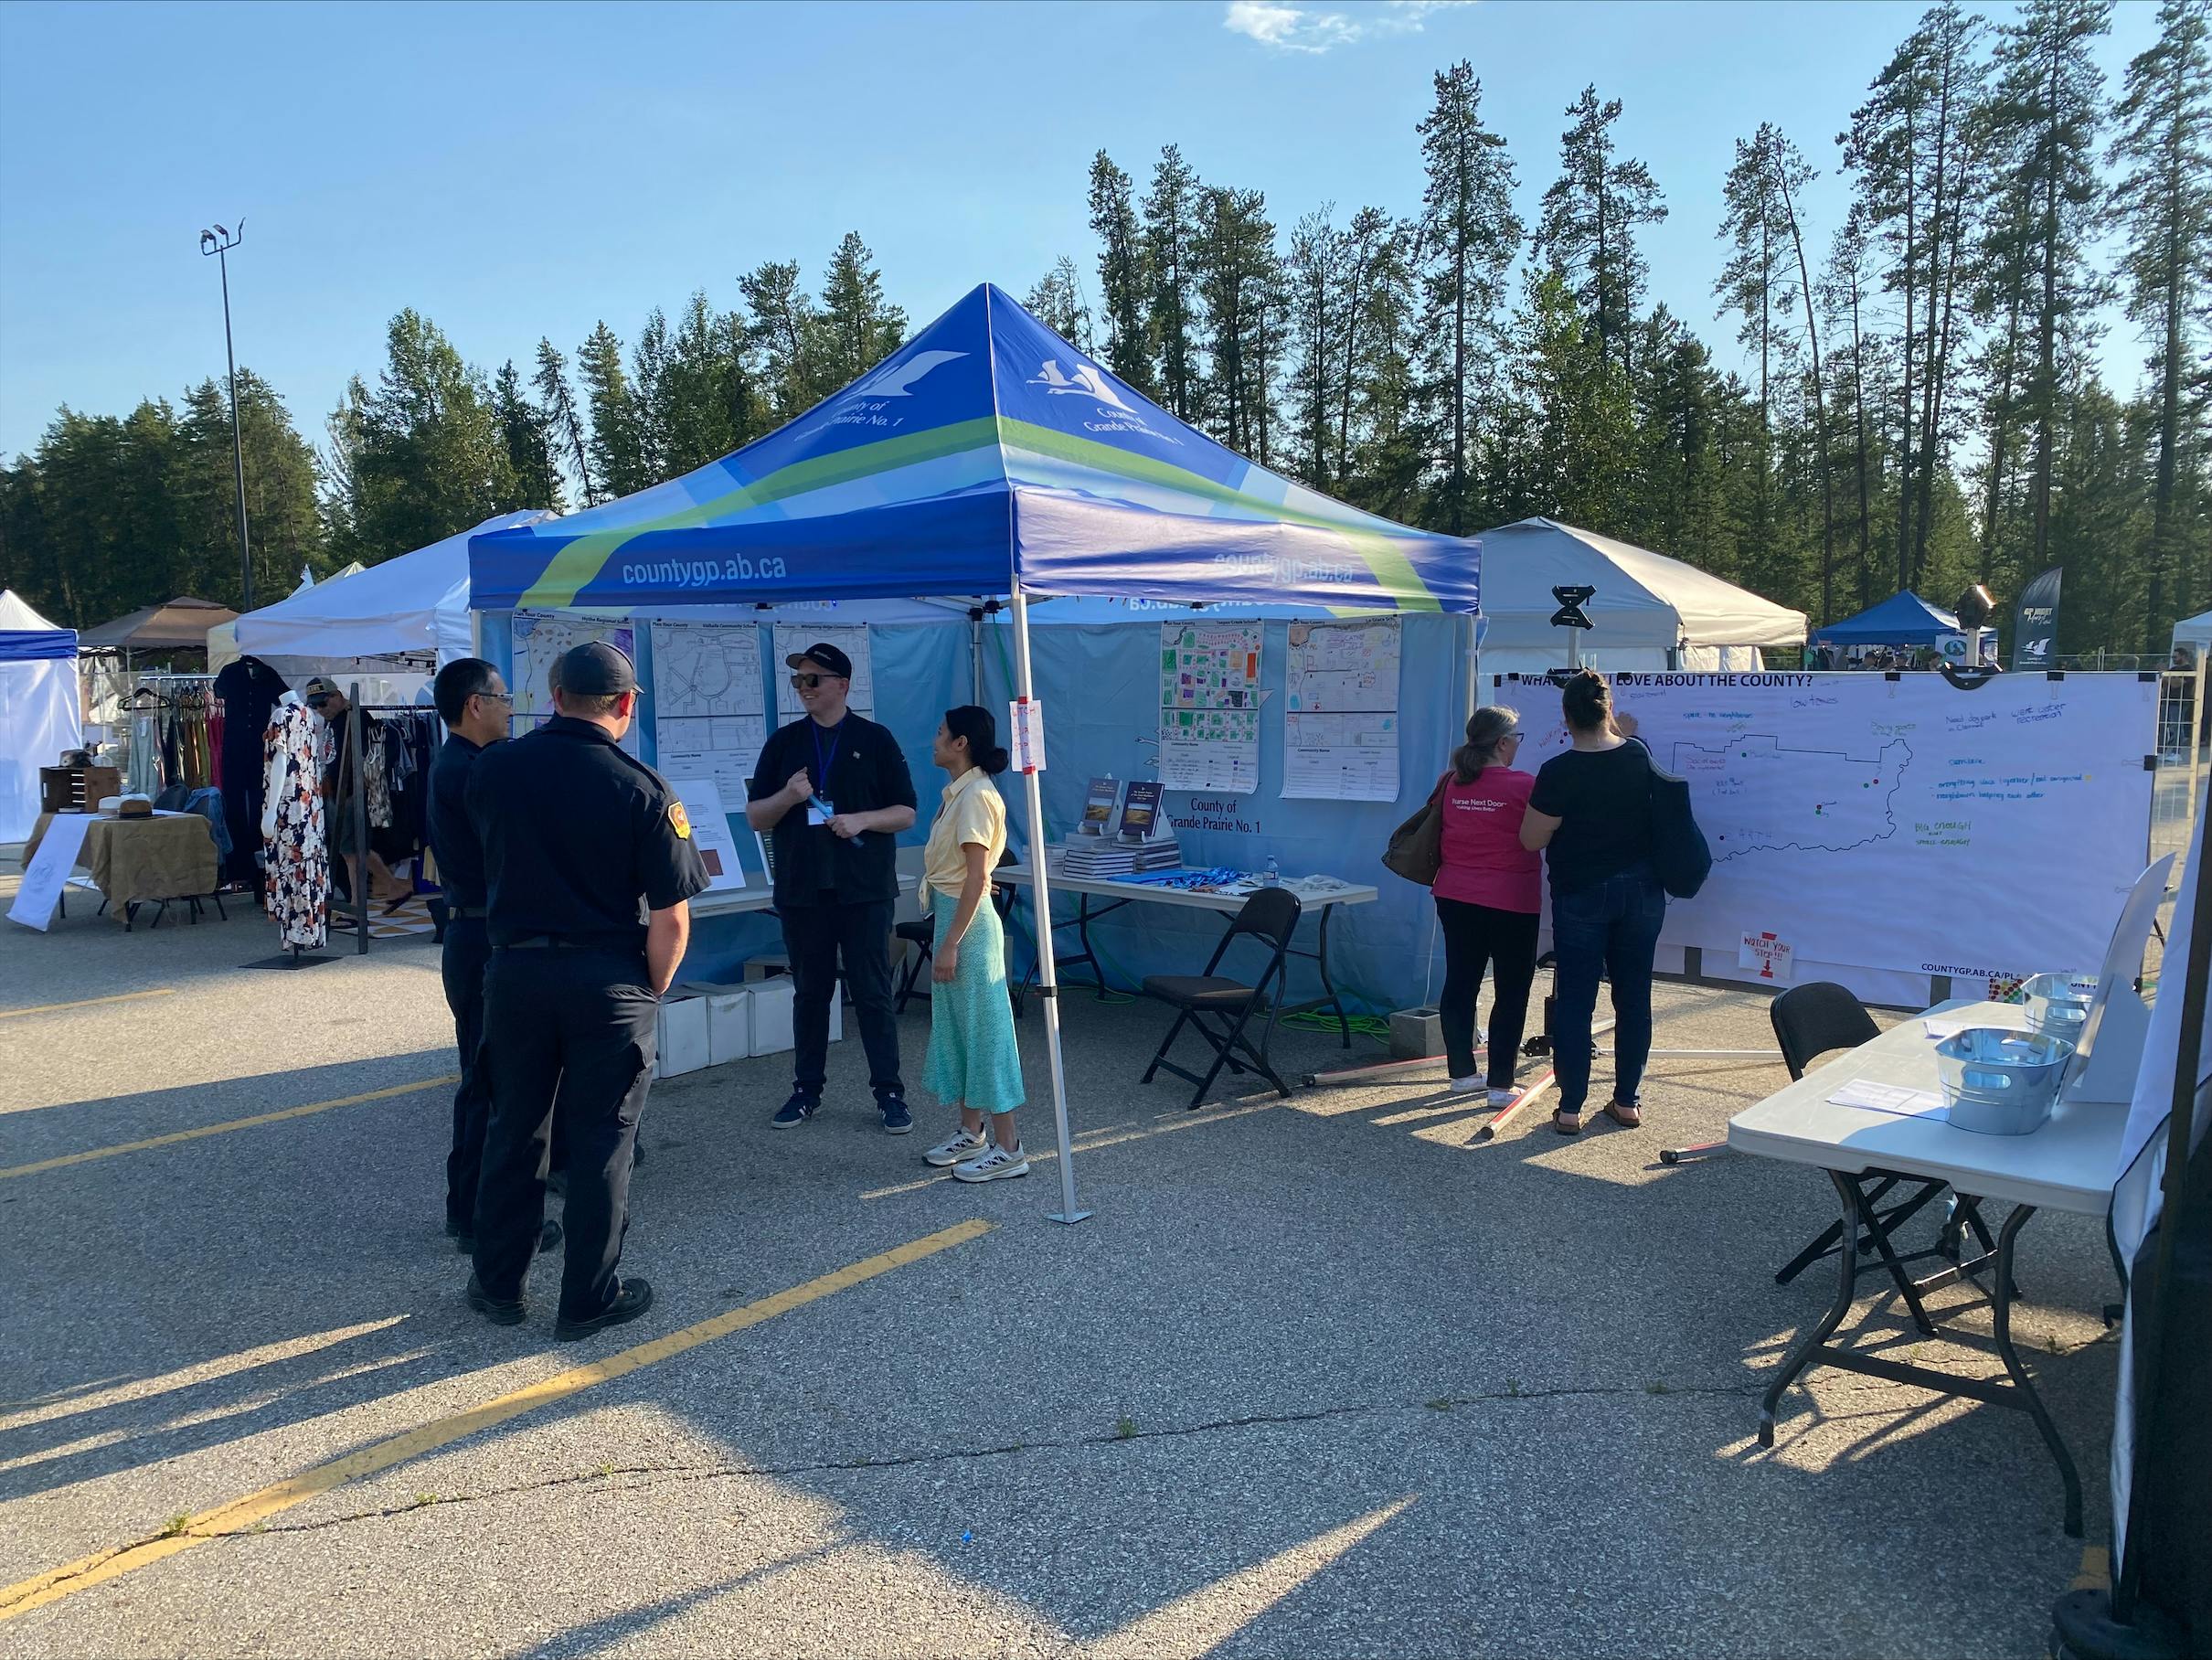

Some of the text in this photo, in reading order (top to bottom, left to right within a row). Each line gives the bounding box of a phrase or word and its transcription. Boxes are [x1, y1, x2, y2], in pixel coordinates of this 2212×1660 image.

[1083, 420, 1128, 433] Grande
[622, 552, 787, 588] countygp.ab.ca
[1214, 551, 1354, 585] countygp.ab.ca
[1522, 675, 1552, 686] WHA
[1616, 675, 1651, 686] LOVE
[1654, 675, 1707, 686] ABOUT
[1708, 675, 1737, 686] THE
[1739, 675, 1813, 686] COUNTY?
[1190, 798, 1237, 816] County of
[1470, 798, 1487, 806] Next
[1203, 816, 1234, 831] Prairie
[1236, 819, 1252, 834] No.
[1255, 821, 1260, 834] 1
[1773, 942, 1791, 953] YOUR
